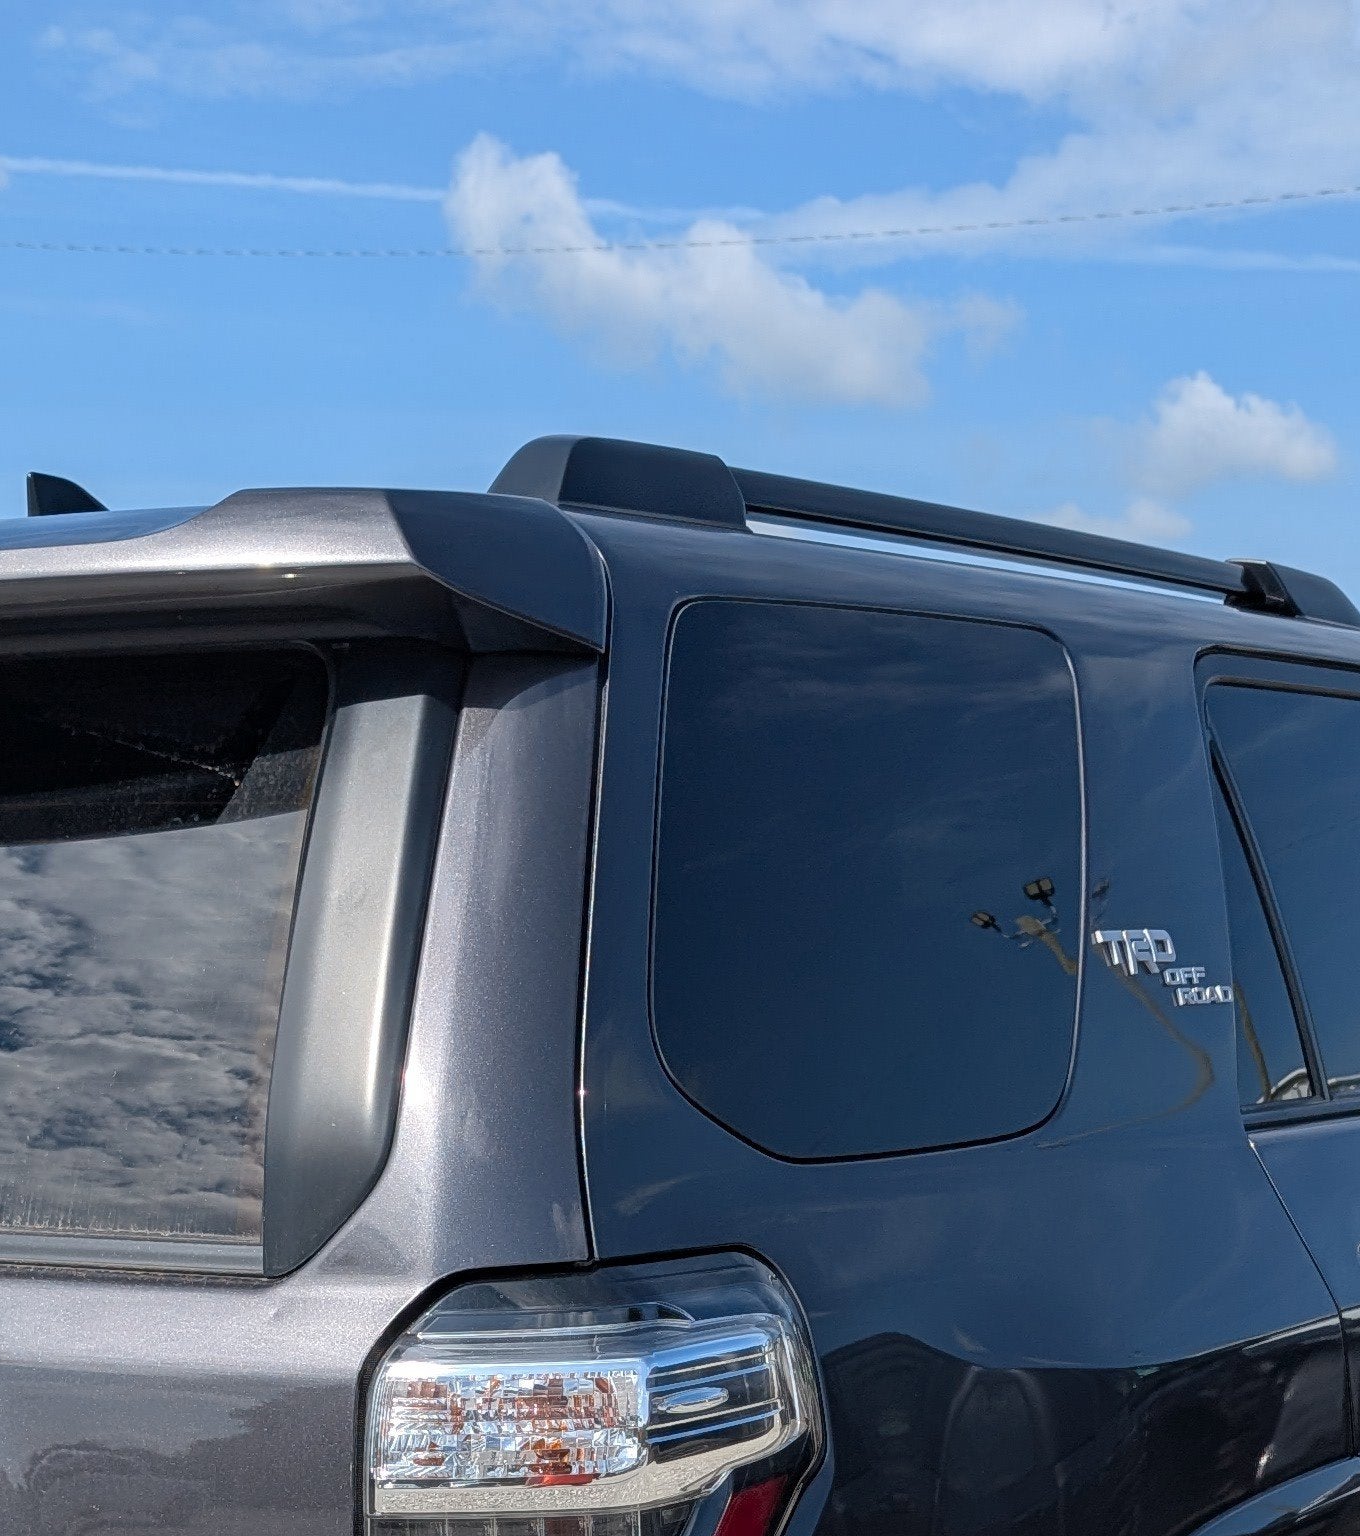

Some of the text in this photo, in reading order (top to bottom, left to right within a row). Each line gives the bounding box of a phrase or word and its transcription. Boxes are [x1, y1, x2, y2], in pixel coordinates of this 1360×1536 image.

[1091, 928, 1176, 976] TRD
[1163, 966, 1205, 986] OFF
[1172, 984, 1234, 1007] ROAD
